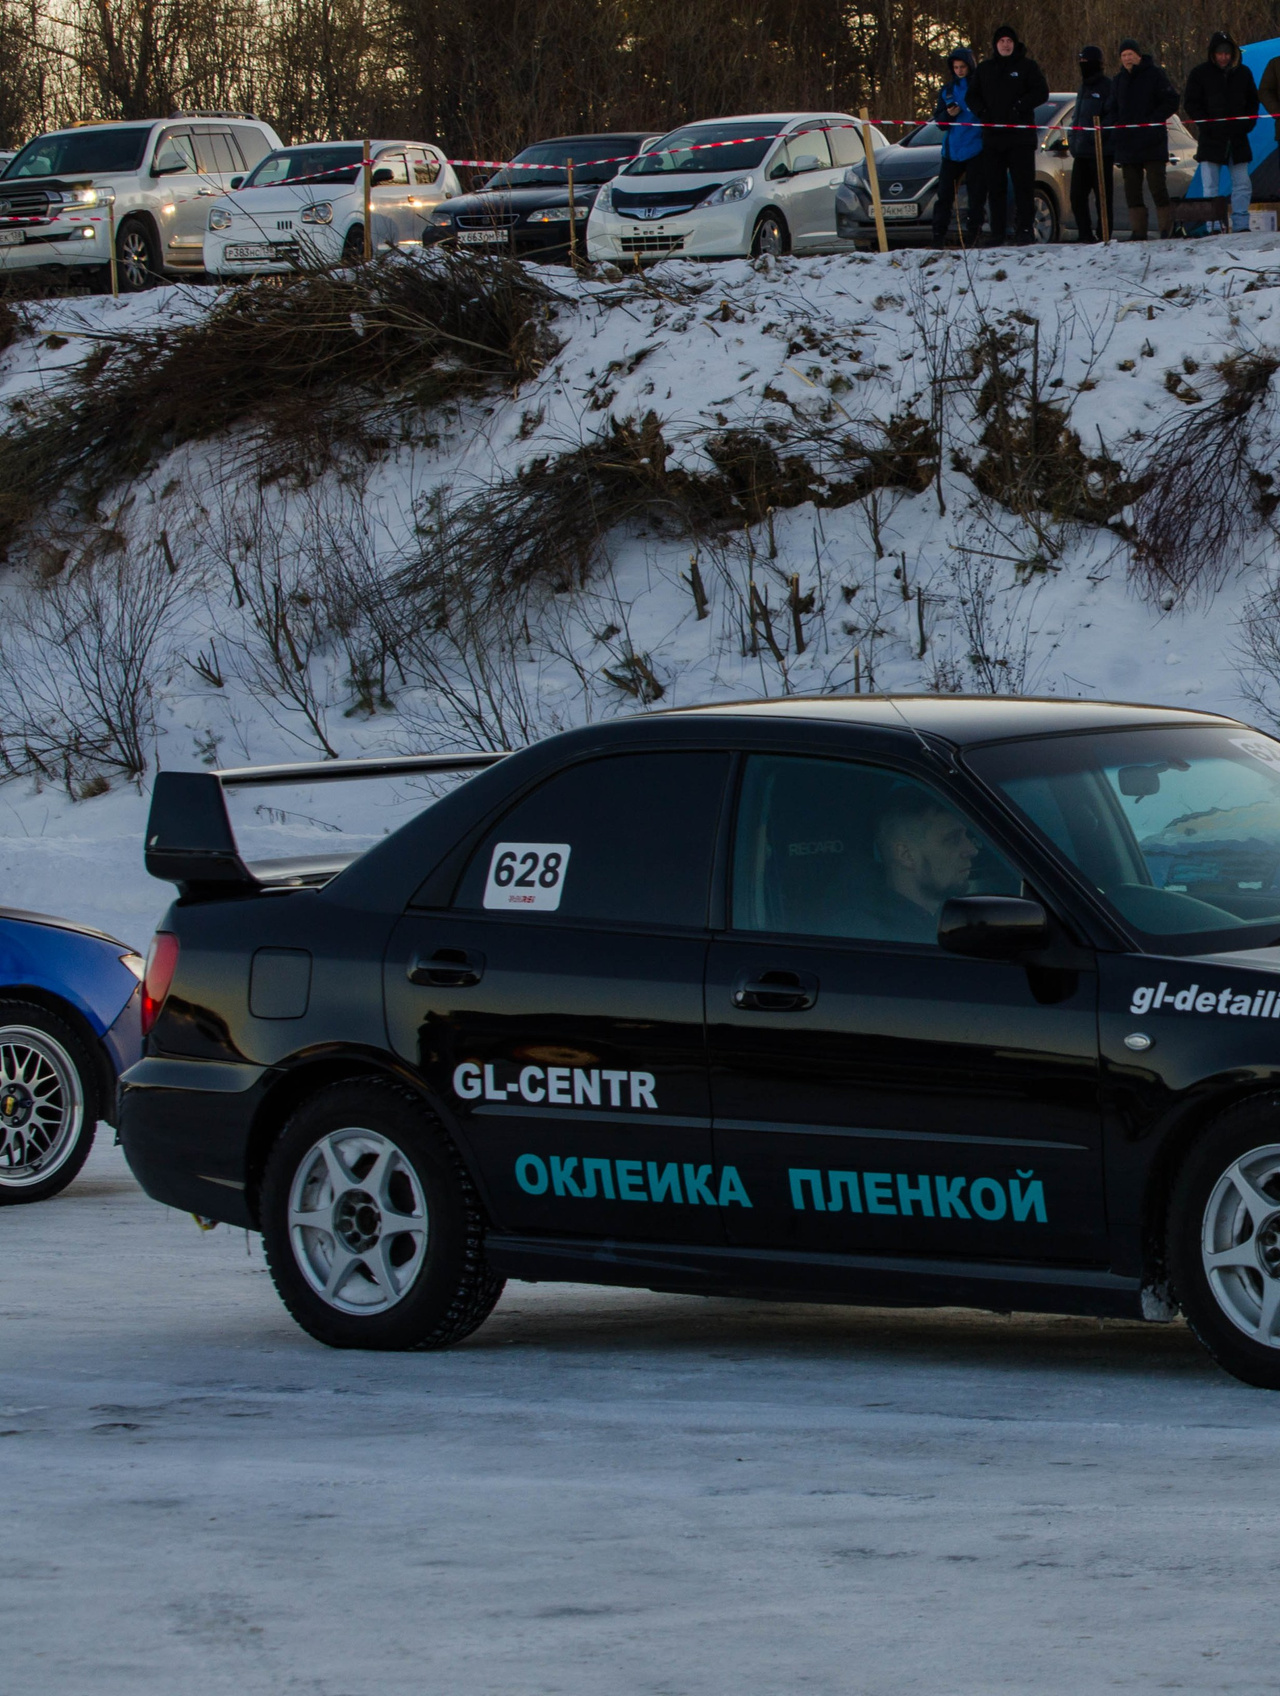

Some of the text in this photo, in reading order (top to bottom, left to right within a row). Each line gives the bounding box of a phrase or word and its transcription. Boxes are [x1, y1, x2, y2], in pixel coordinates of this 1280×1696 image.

[494, 851, 562, 888] 628
[453, 1062, 658, 1108] GL-CENTR
[788, 1168, 1048, 1223] ПЛЕНКОЙ
